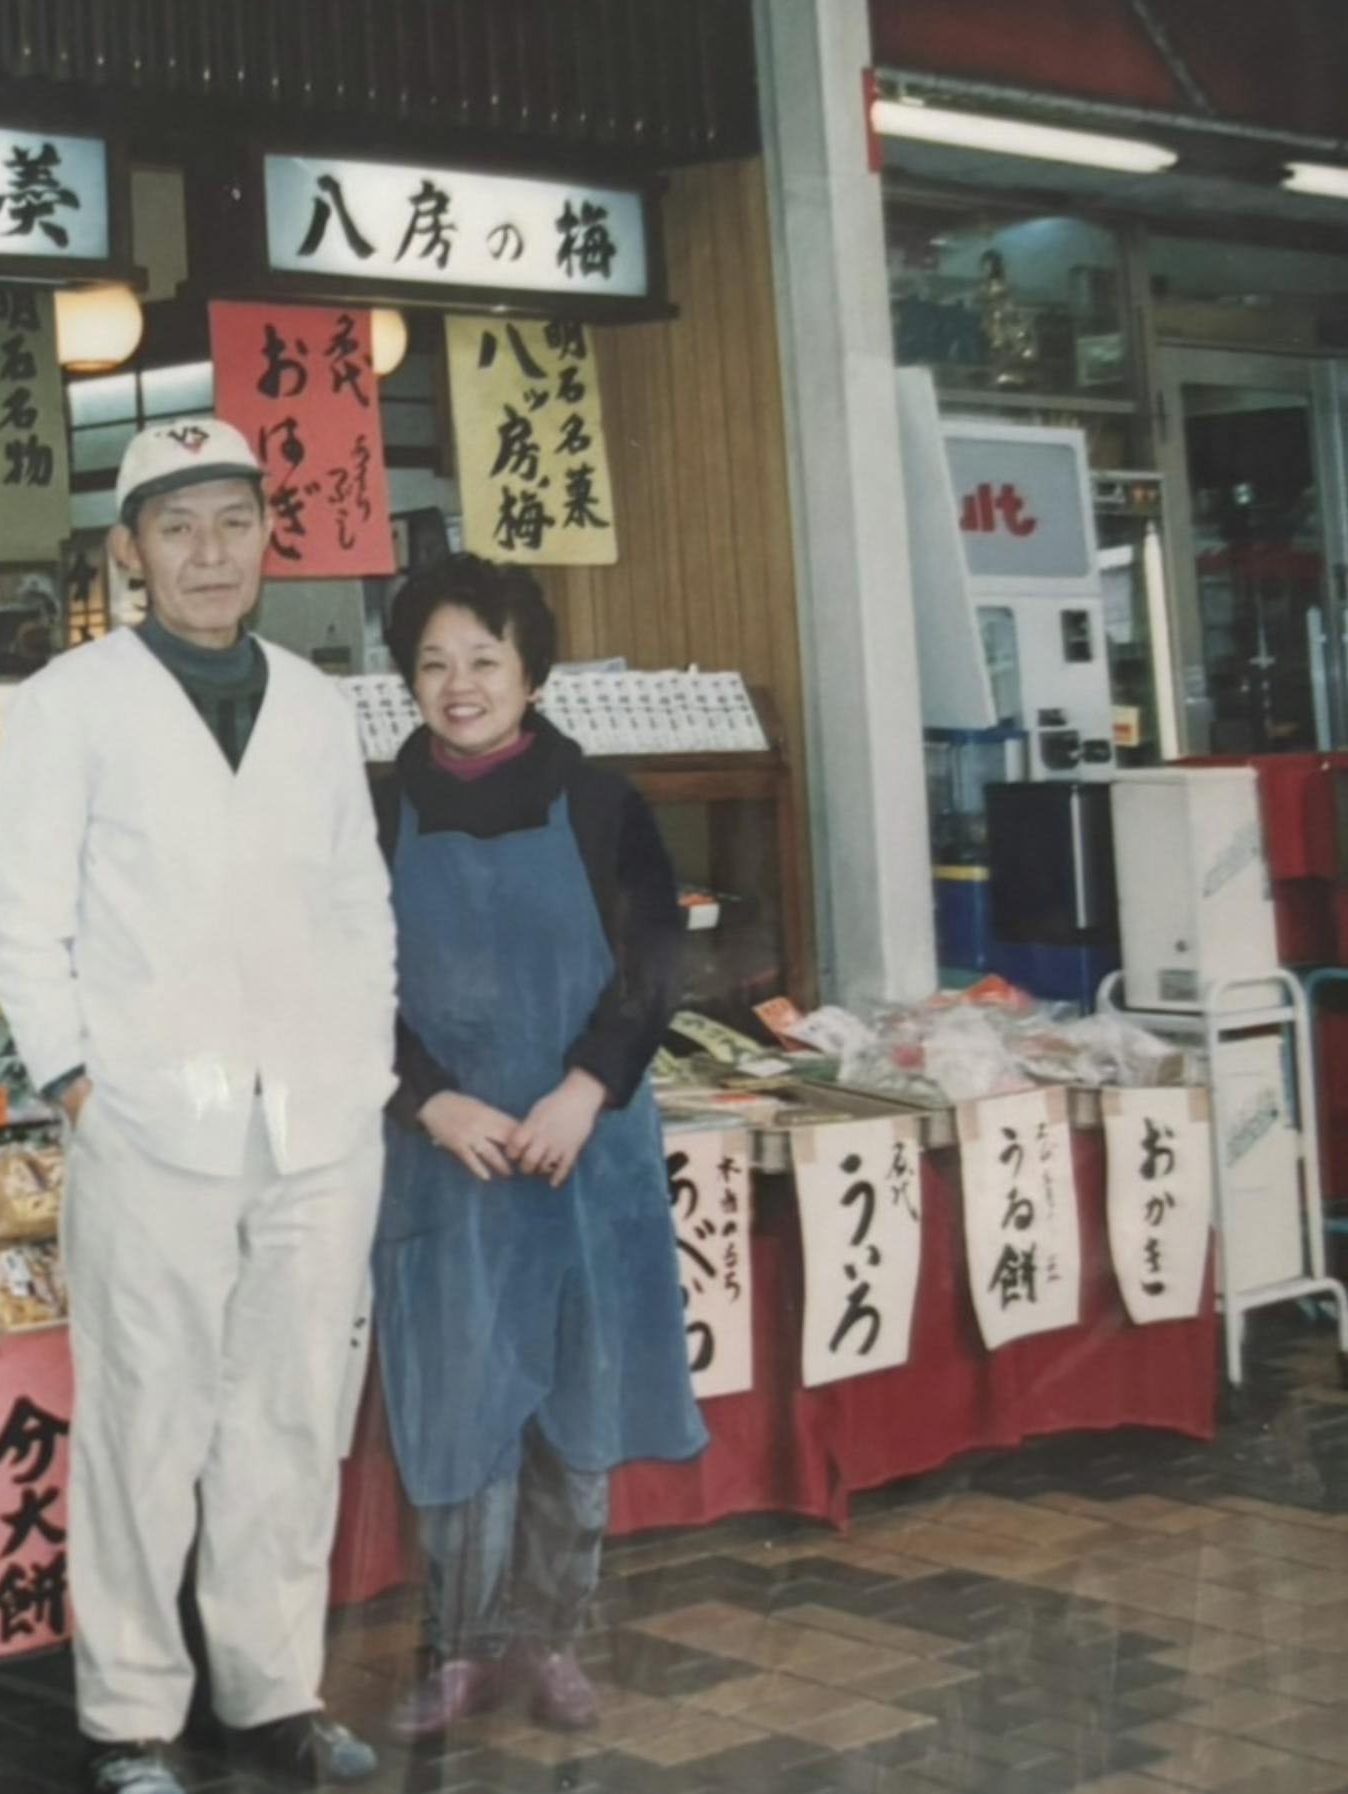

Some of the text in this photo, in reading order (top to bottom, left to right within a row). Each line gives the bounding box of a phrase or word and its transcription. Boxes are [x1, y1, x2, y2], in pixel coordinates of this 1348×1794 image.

[295, 173, 617, 280] 八房の梅
[256, 322, 321, 561] おはぎ
[543, 319, 611, 529] 明石名菓
[827, 1152, 883, 1357] ういろ
[1138, 1116, 1177, 1297] おかき
